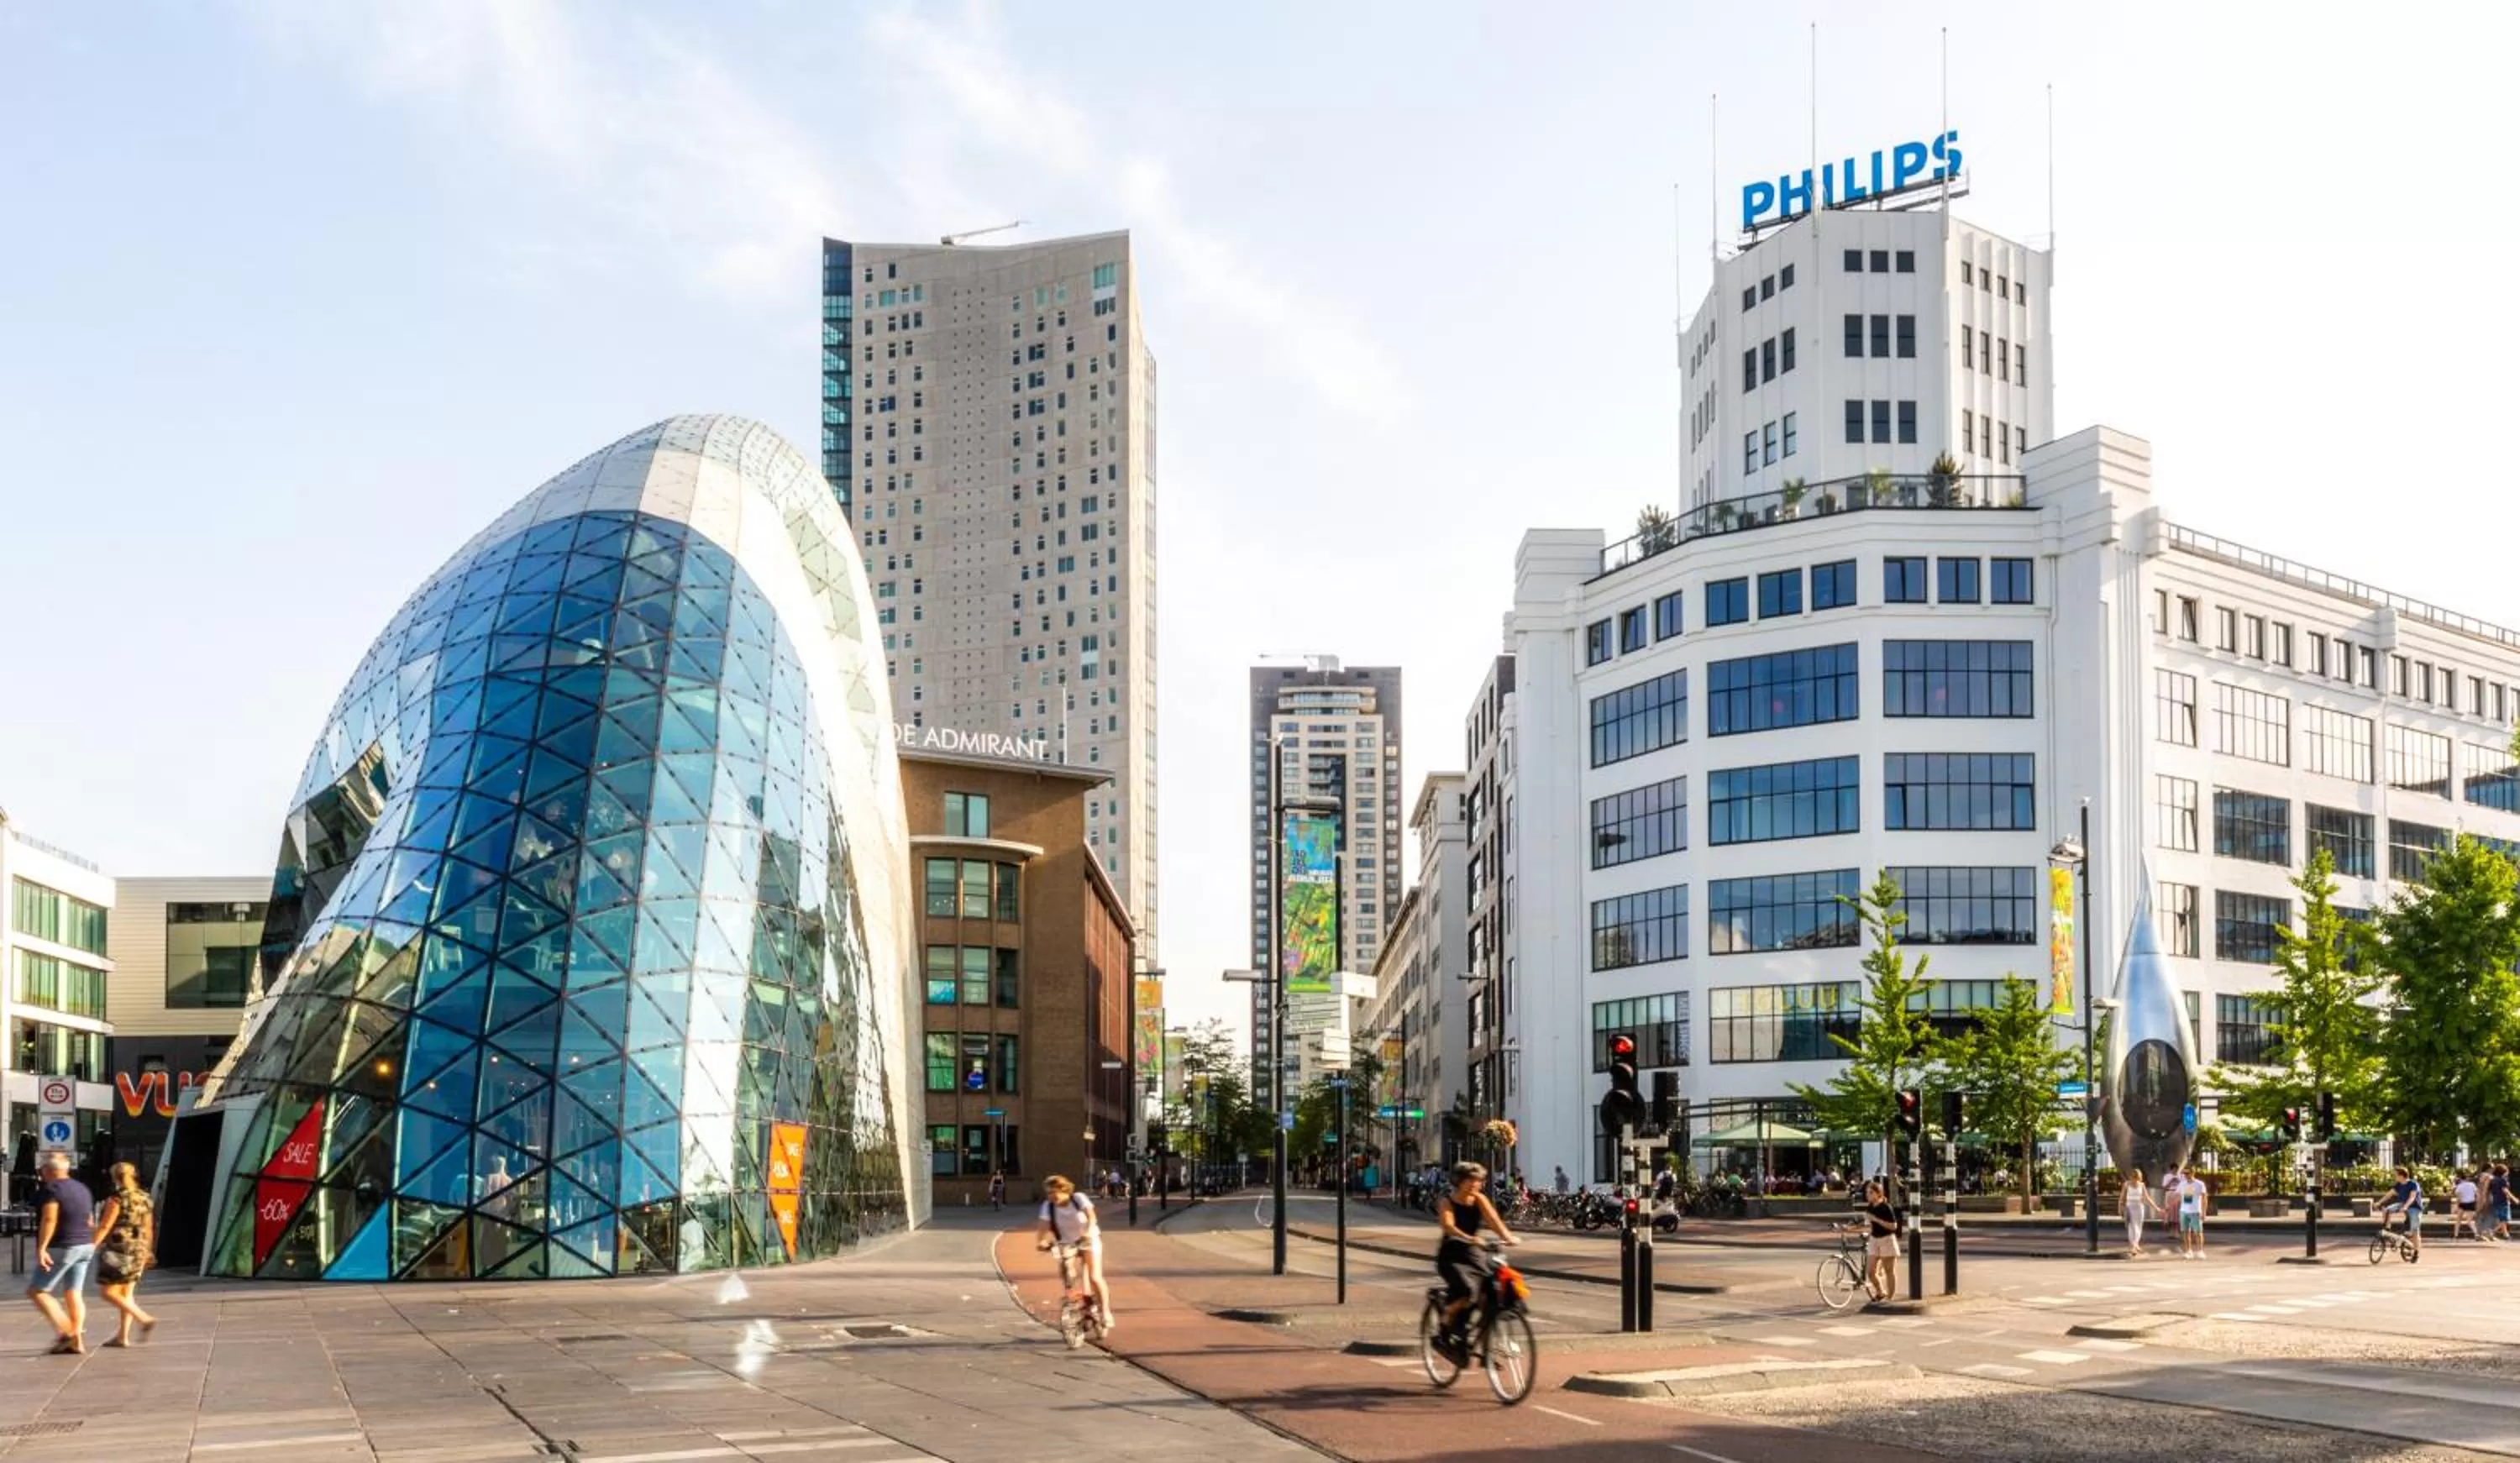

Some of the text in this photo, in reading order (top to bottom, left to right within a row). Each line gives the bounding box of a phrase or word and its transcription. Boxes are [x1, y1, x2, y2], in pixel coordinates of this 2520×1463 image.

[1743, 130, 1962, 228] PHILIPS
[924, 726, 1049, 760] ADMIRANT
[283, 1142, 315, 1164] SALE
[260, 1198, 291, 1221] -60%
